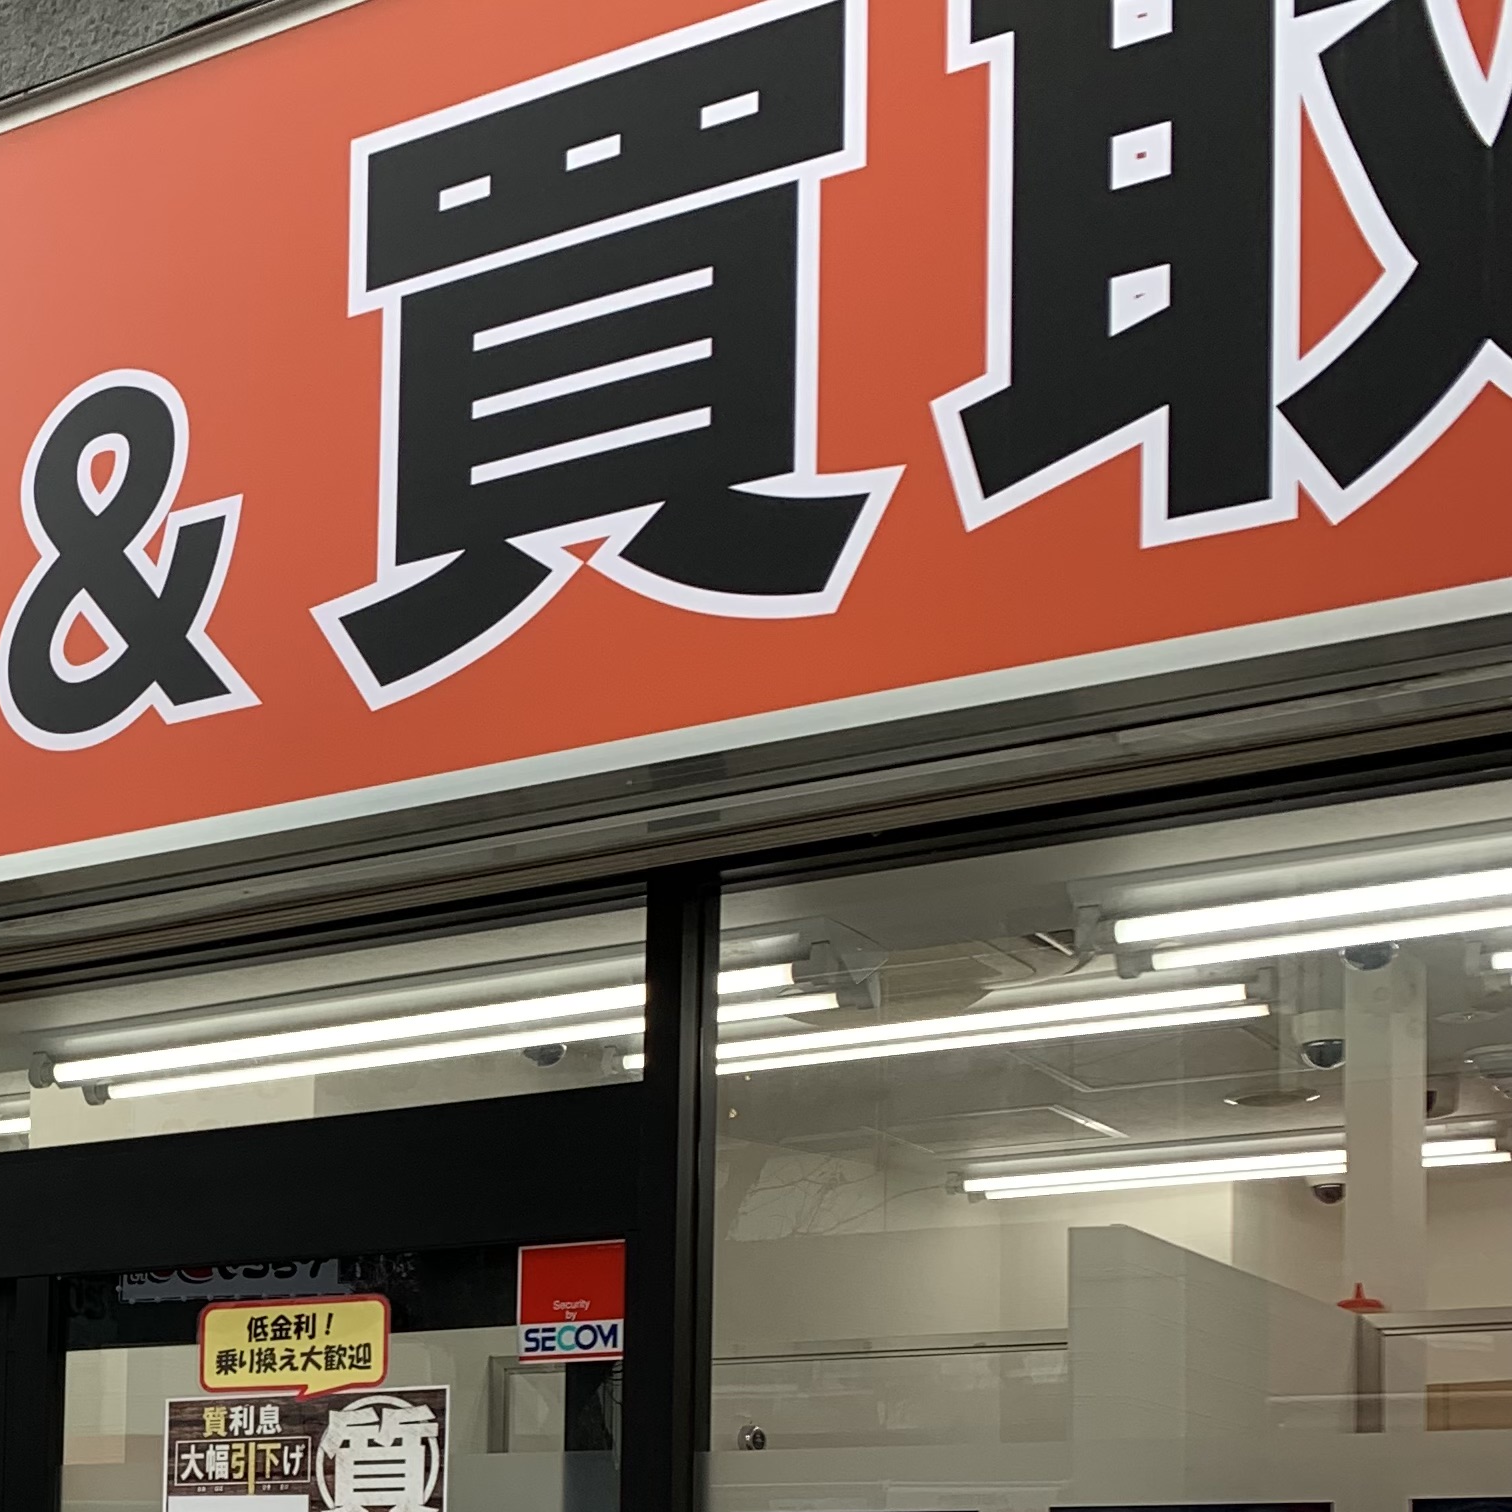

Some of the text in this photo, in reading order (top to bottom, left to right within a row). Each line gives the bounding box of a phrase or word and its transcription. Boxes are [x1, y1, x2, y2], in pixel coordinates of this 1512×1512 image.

[552, 1299, 591, 1311] Security
[564, 1310, 578, 1321] by
[247, 1312, 335, 1341] 低金利!
[524, 1324, 618, 1352] SECOM
[214, 1342, 372, 1375] 乗り換え大歓迎
[202, 1403, 283, 1438] 質利息
[180, 1441, 306, 1494] 大幅引下げ
